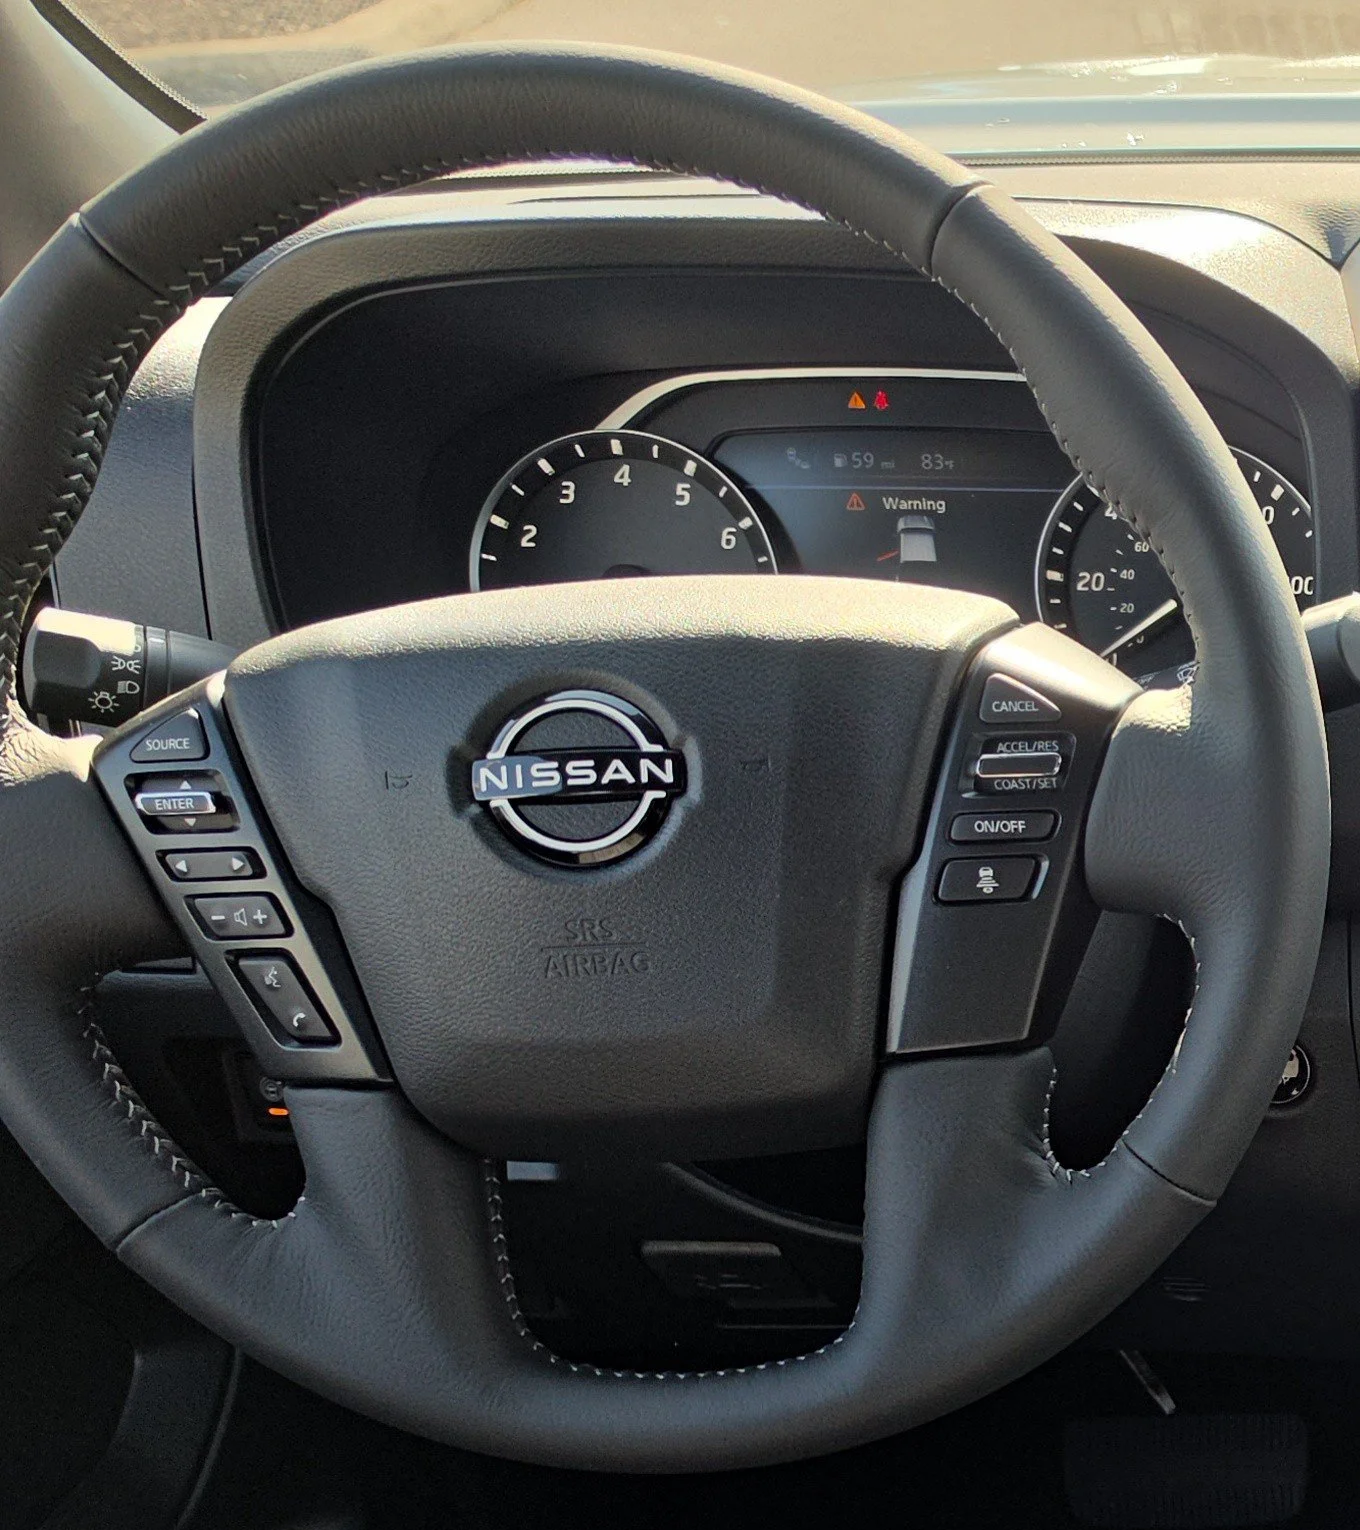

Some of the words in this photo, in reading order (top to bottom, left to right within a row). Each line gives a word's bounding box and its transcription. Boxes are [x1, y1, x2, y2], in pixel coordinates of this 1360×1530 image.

[851, 452, 875, 469] 59
[613, 464, 631, 486] 4
[559, 481, 576, 504] 3
[675, 483, 691, 506] 5
[882, 496, 947, 514] Warning
[520, 525, 536, 548] 2
[721, 527, 737, 550] 6
[1076, 572, 1105, 591] 20
[1120, 569, 1135, 580] 40
[1291, 576, 1314, 595] 00
[1120, 602, 1135, 613] 20
[991, 701, 1039, 713] CANCEL
[145, 737, 191, 752] SOURCE
[996, 740, 1060, 753] ACCEL/RES
[479, 757, 675, 793] NISSAN
[993, 778, 1058, 791] COAST/SET
[154, 797, 195, 811] ENTER
[974, 820, 1027, 834] ON/OFF
[564, 918, 616, 943] SRS
[544, 951, 652, 979] AIRBAG
